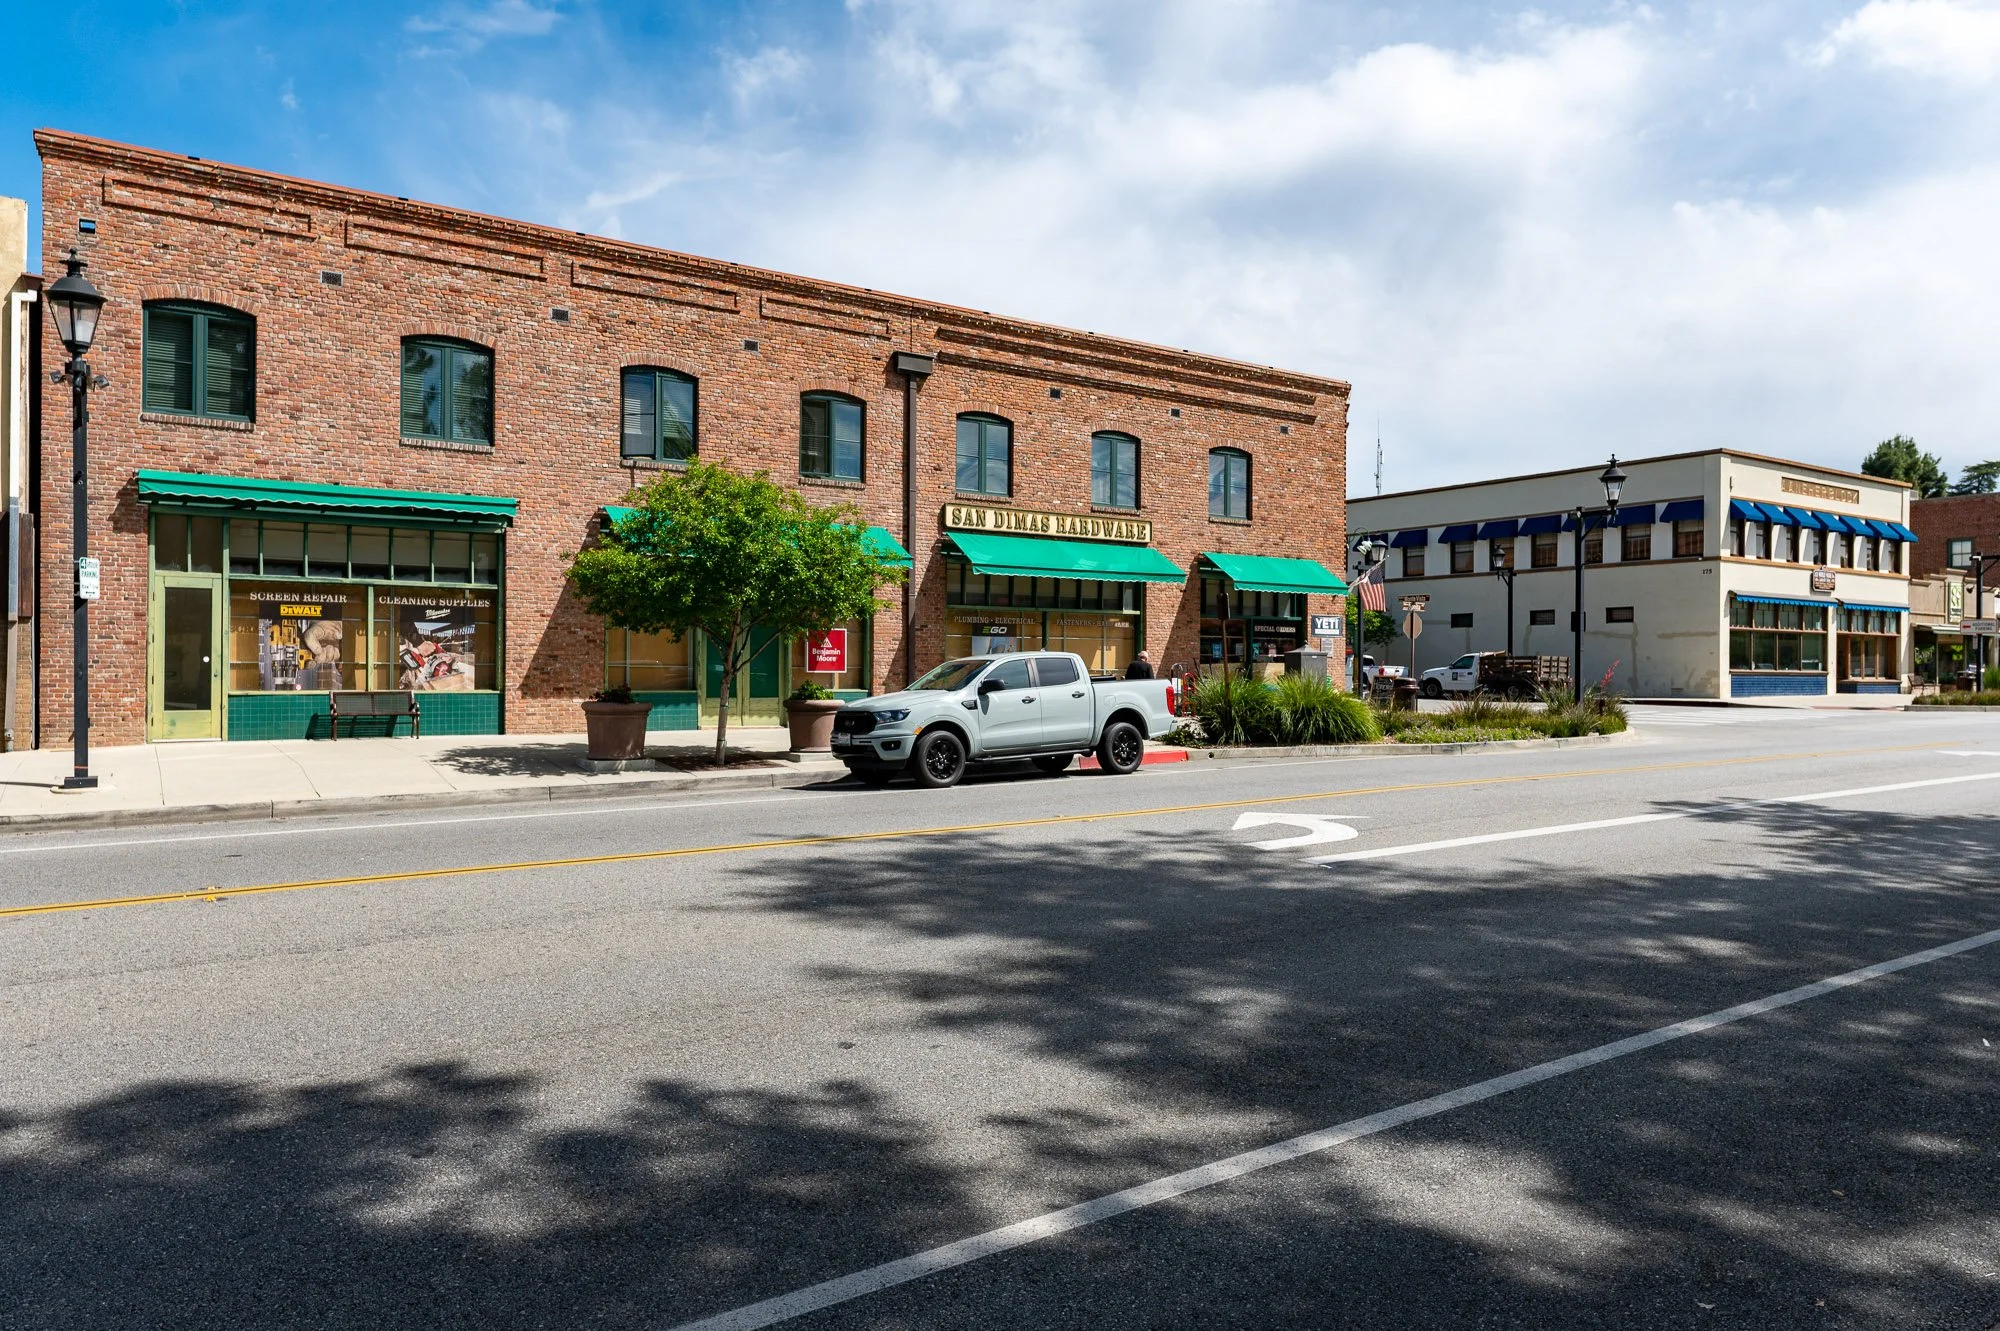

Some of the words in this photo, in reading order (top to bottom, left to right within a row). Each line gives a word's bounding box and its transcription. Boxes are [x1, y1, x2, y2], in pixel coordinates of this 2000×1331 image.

[952, 507, 987, 527] SAN
[993, 510, 1050, 533] DIMAS
[1056, 516, 1147, 540] HARDWARE
[249, 591, 300, 602] SCREEN
[303, 593, 348, 603] REPAIR
[379, 595, 437, 606] CLEANING
[439, 597, 491, 608] SUPPLIES
[280, 605, 322, 616] DEWALT
[954, 615, 989, 624] PLUMBING
[995, 617, 1036, 625] ELECTRICAL
[1056, 618, 1092, 627] FASTENERS
[1315, 617, 1339, 629] YETI
[982, 626, 1008, 634] EGO
[812, 647, 841, 656] Benjamin
[816, 654, 837, 662] Moore
